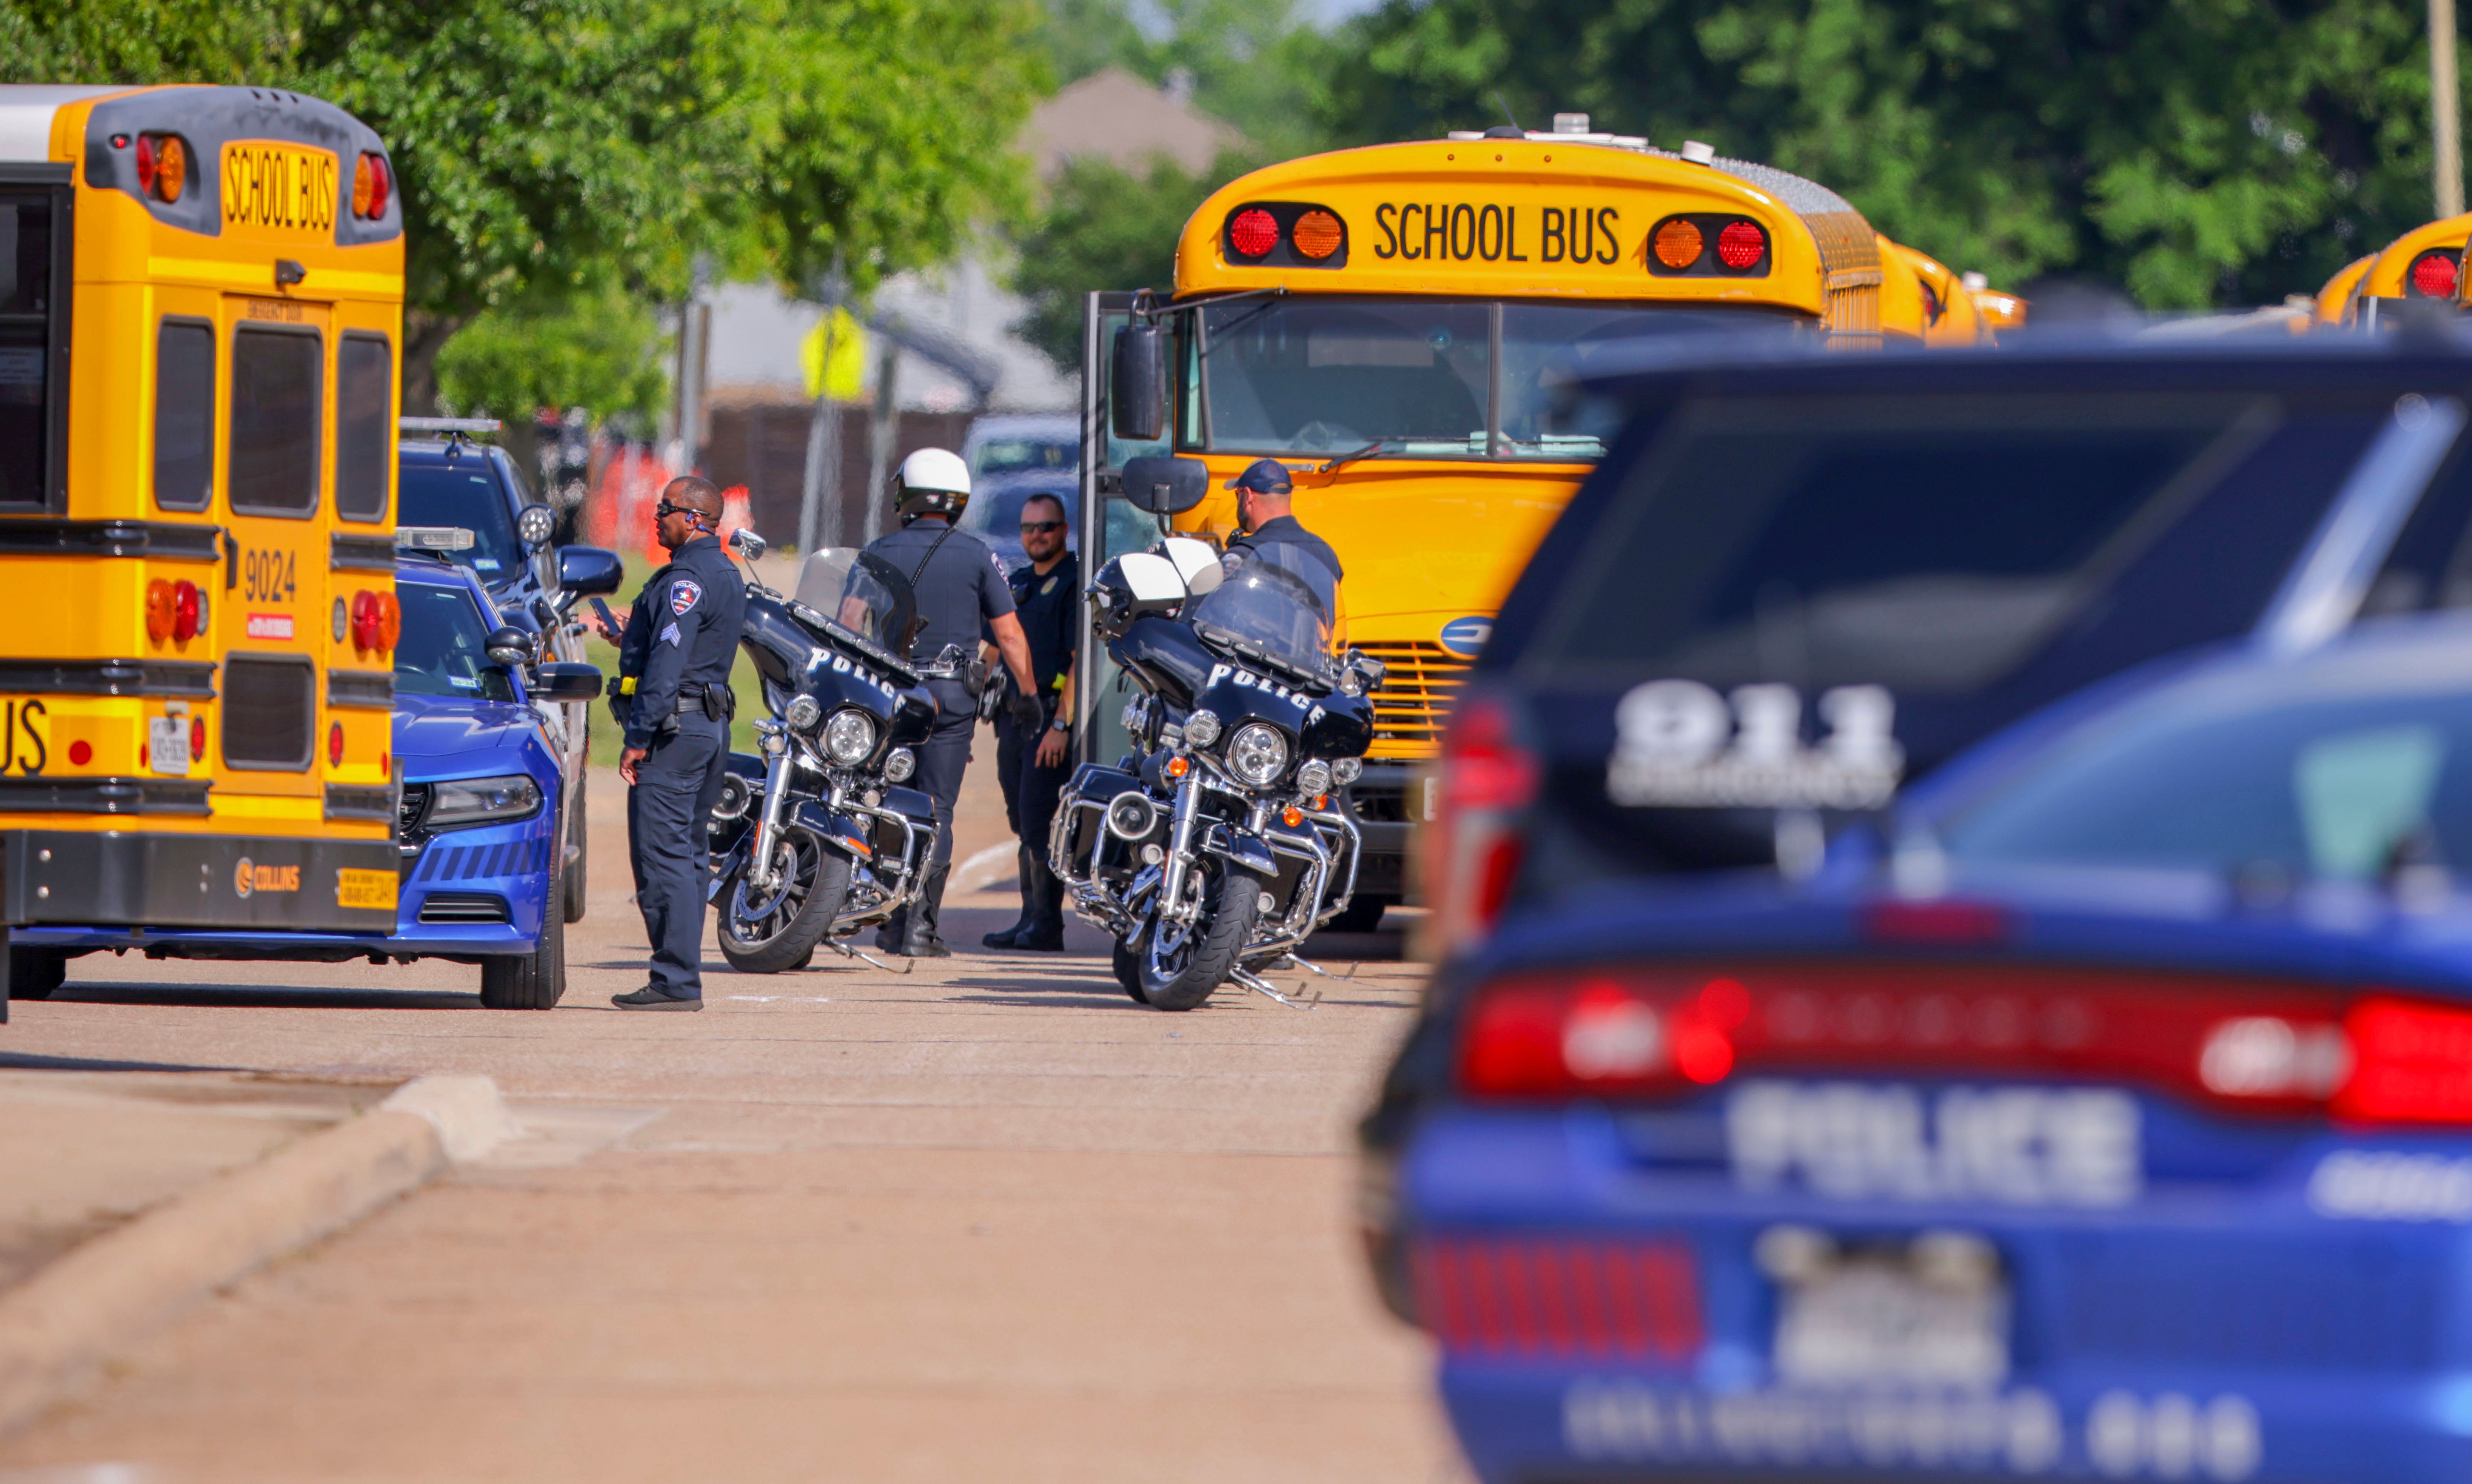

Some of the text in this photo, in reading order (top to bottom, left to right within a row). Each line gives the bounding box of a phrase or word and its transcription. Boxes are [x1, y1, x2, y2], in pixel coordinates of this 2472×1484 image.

[226, 148, 332, 230] SCHOOL BUS
[1375, 203, 1620, 265] SCHOOL BUS
[245, 549, 295, 602] 9024
[676, 582, 699, 593] POLICE
[806, 647, 906, 714] POLICE
[1206, 663, 1326, 726] POLICE
[1615, 679, 1895, 770] 911
[254, 865, 300, 892] COLLINS
[1727, 1081, 2142, 1207] POLICE
